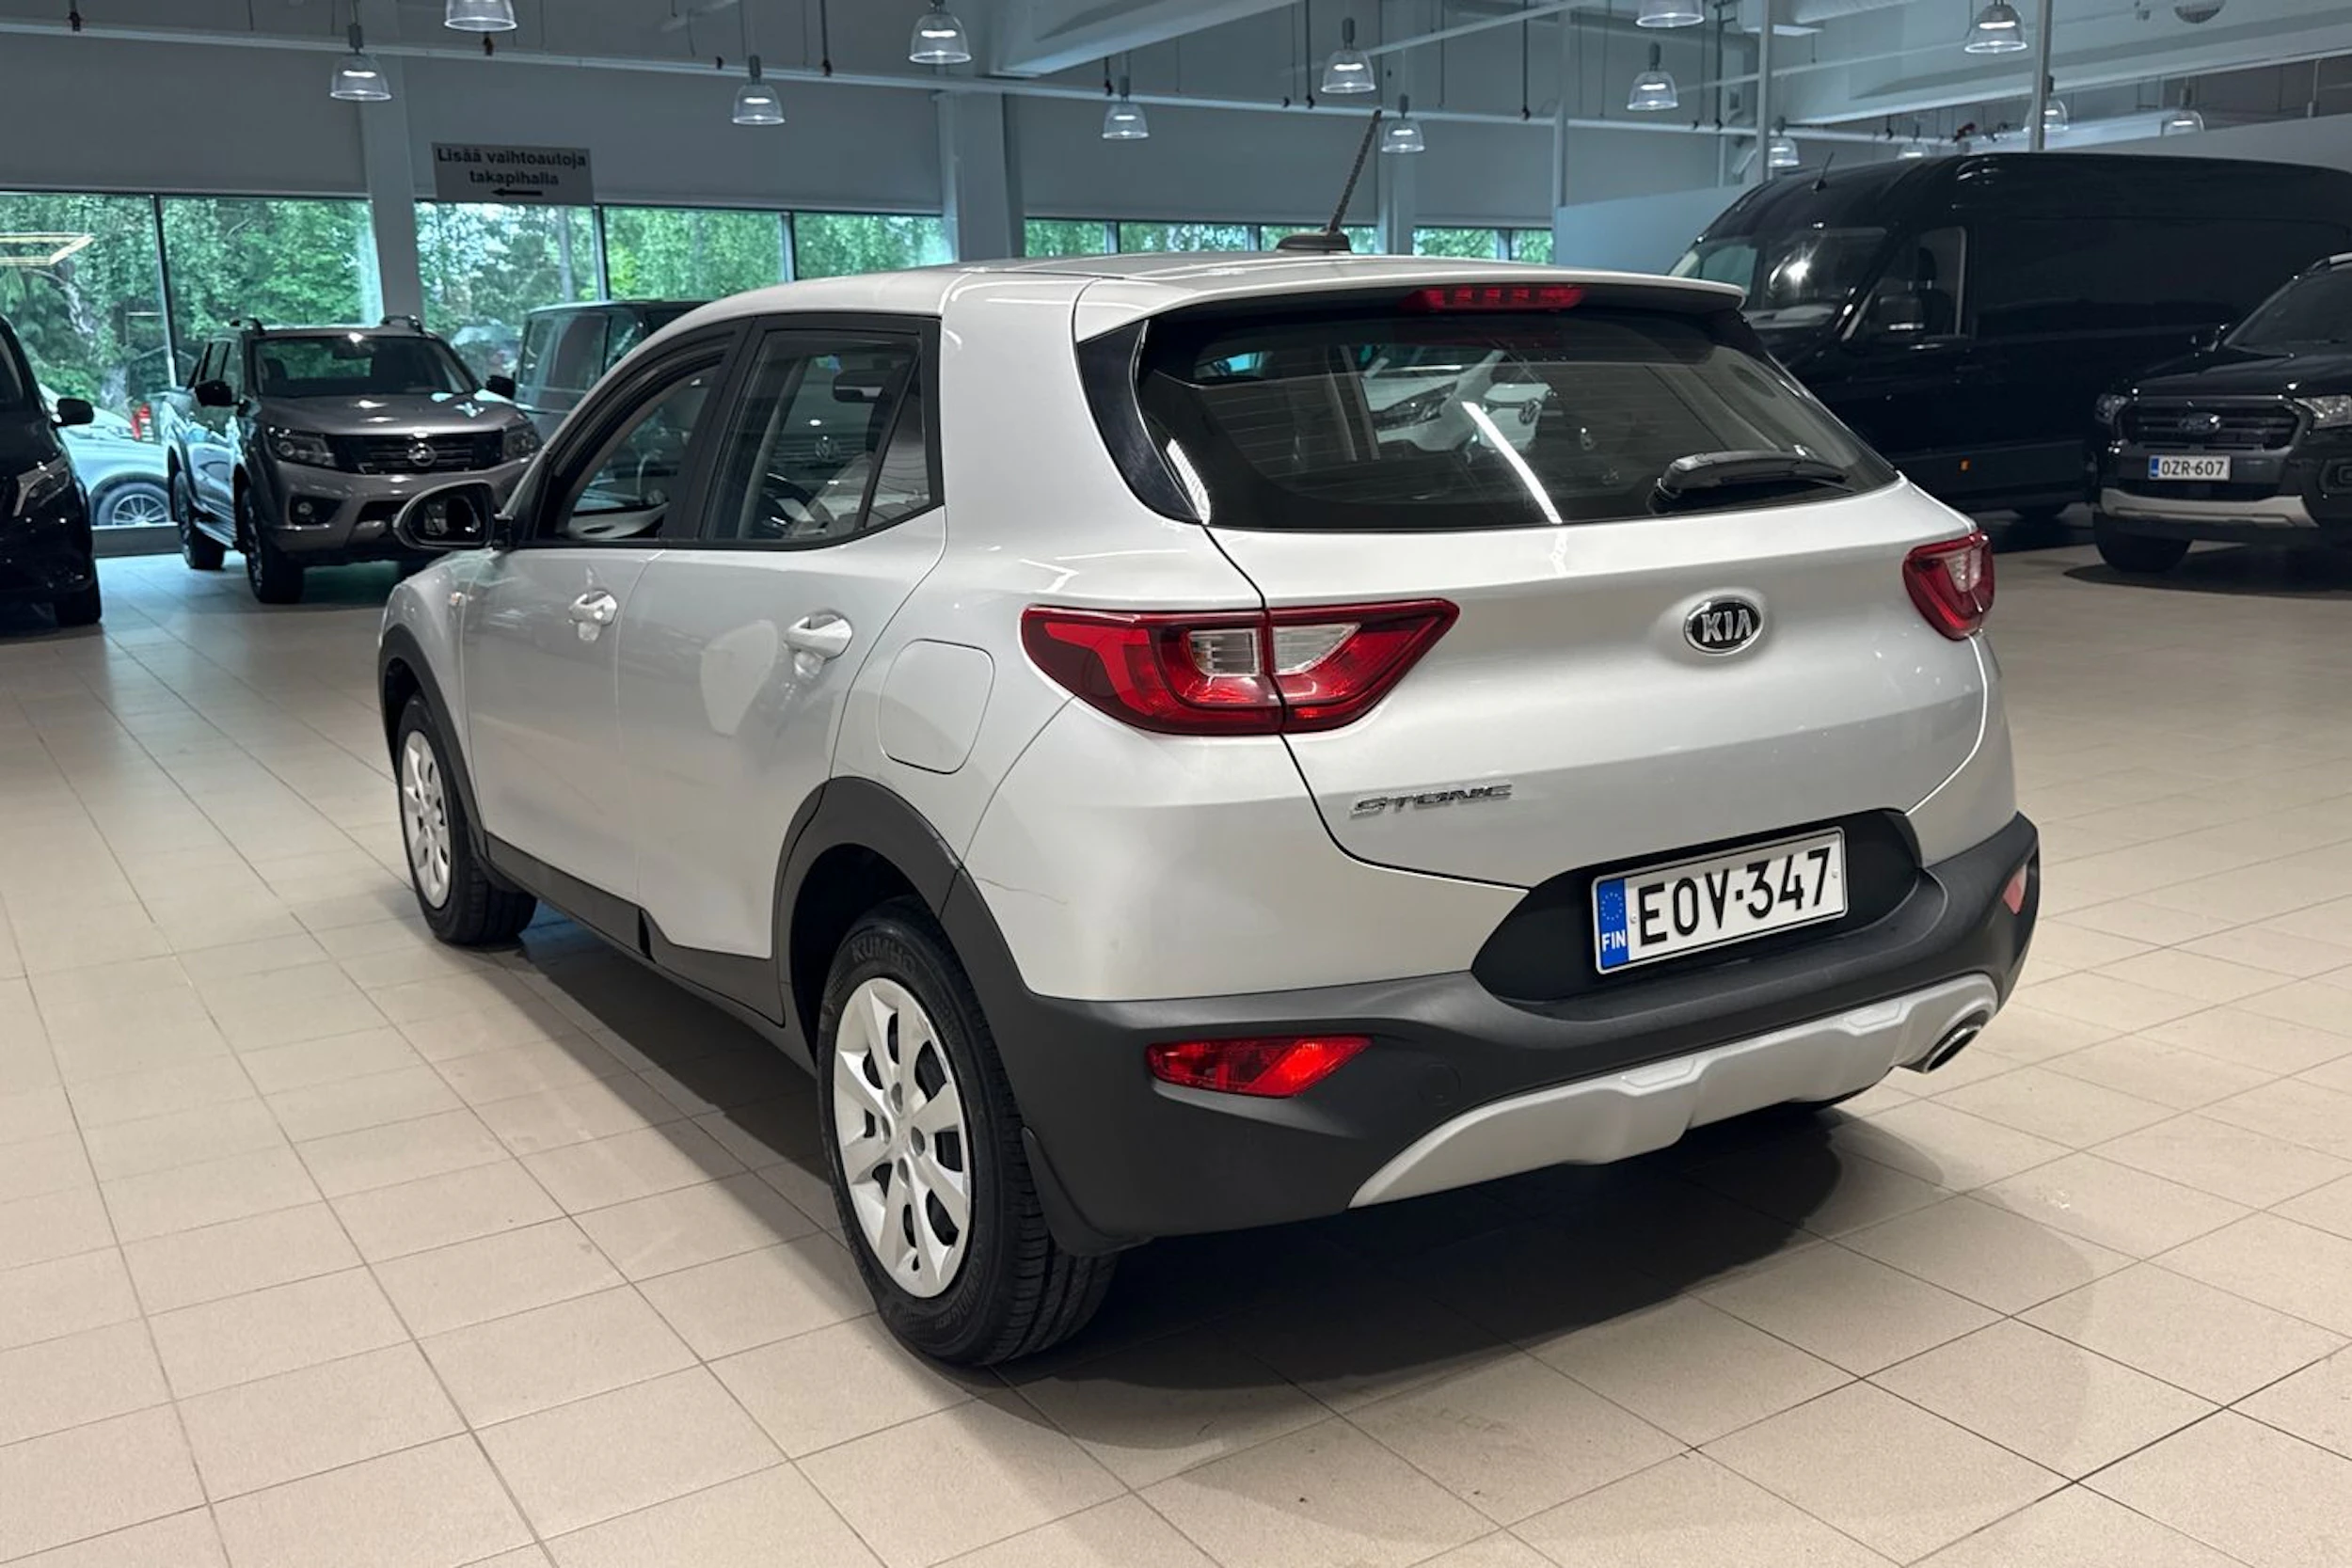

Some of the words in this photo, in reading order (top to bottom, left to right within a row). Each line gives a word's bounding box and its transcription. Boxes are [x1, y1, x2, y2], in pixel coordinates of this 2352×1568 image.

[437, 148, 482, 163] Lisää
[486, 150, 586, 170] vaihtoautoja
[469, 170, 560, 187] takapihalla
[2161, 460, 2224, 476] OZR-607
[1701, 609, 1753, 642] KIA
[1352, 784, 1513, 816] STONIC
[1638, 847, 1831, 946] EOV-347
[1601, 928, 1627, 951] FIN
